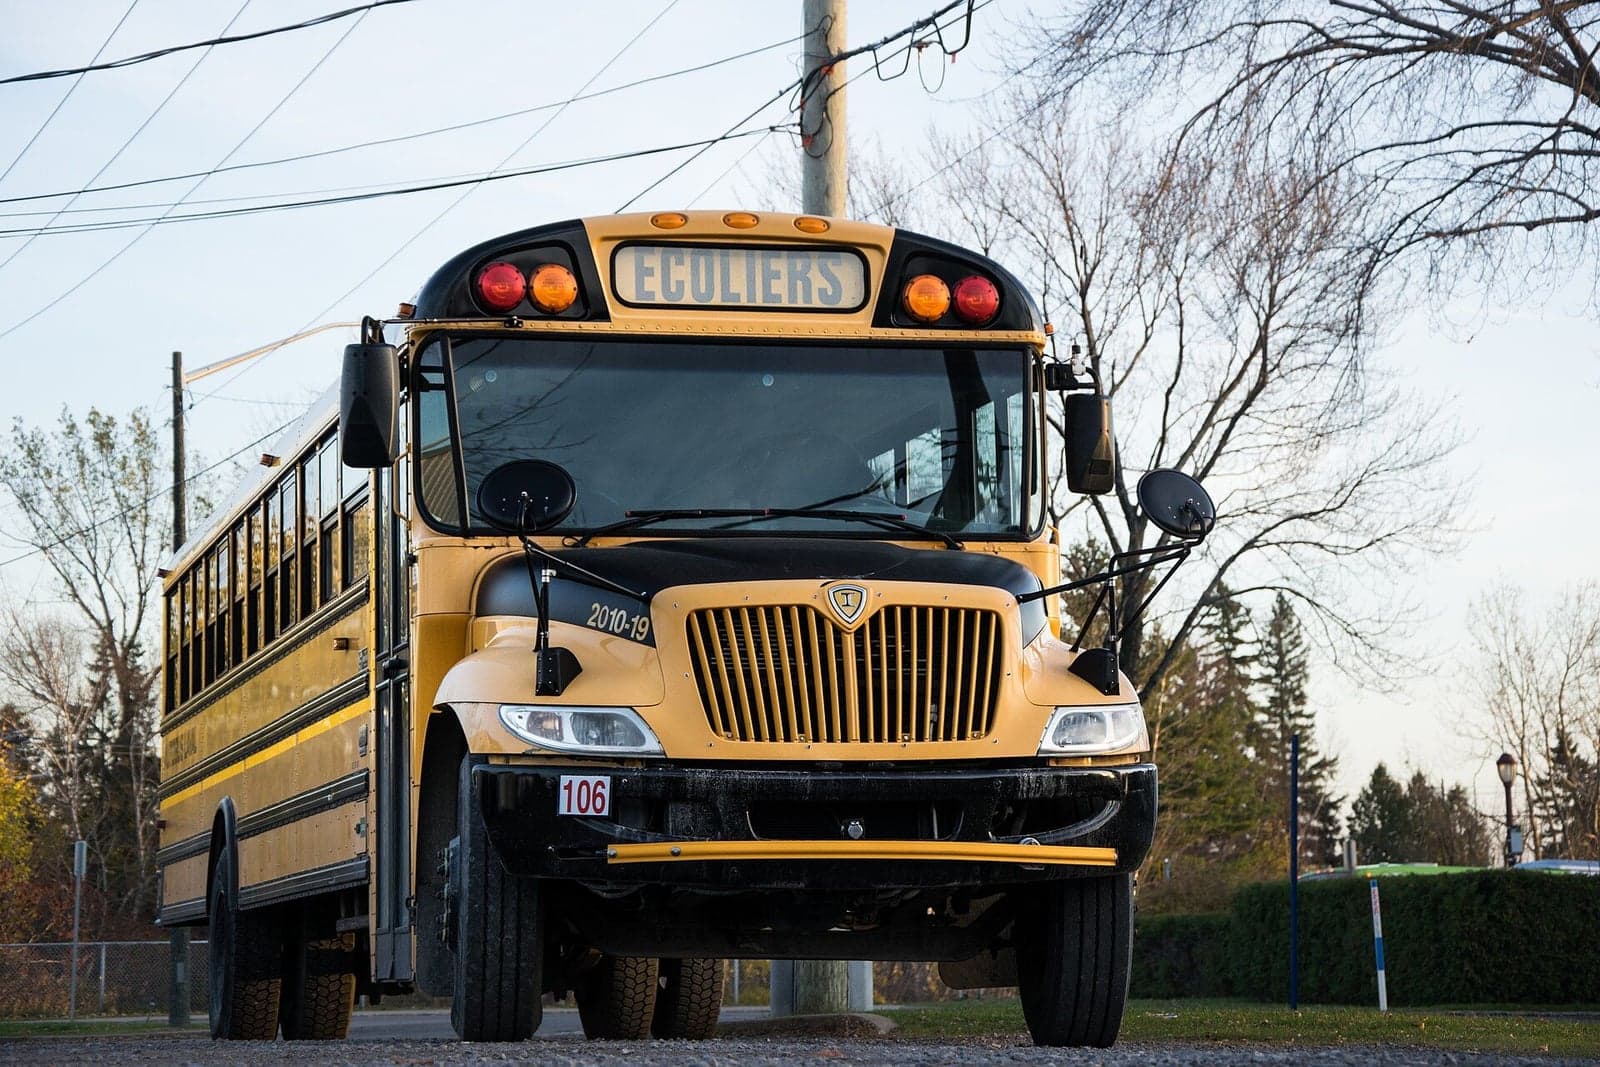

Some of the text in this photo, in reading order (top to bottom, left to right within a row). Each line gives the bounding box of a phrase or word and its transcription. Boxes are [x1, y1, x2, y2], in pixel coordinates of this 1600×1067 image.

[634, 247, 843, 306] ECOLIERS
[586, 602, 650, 641] 2010-19
[563, 779, 606, 815] 106
